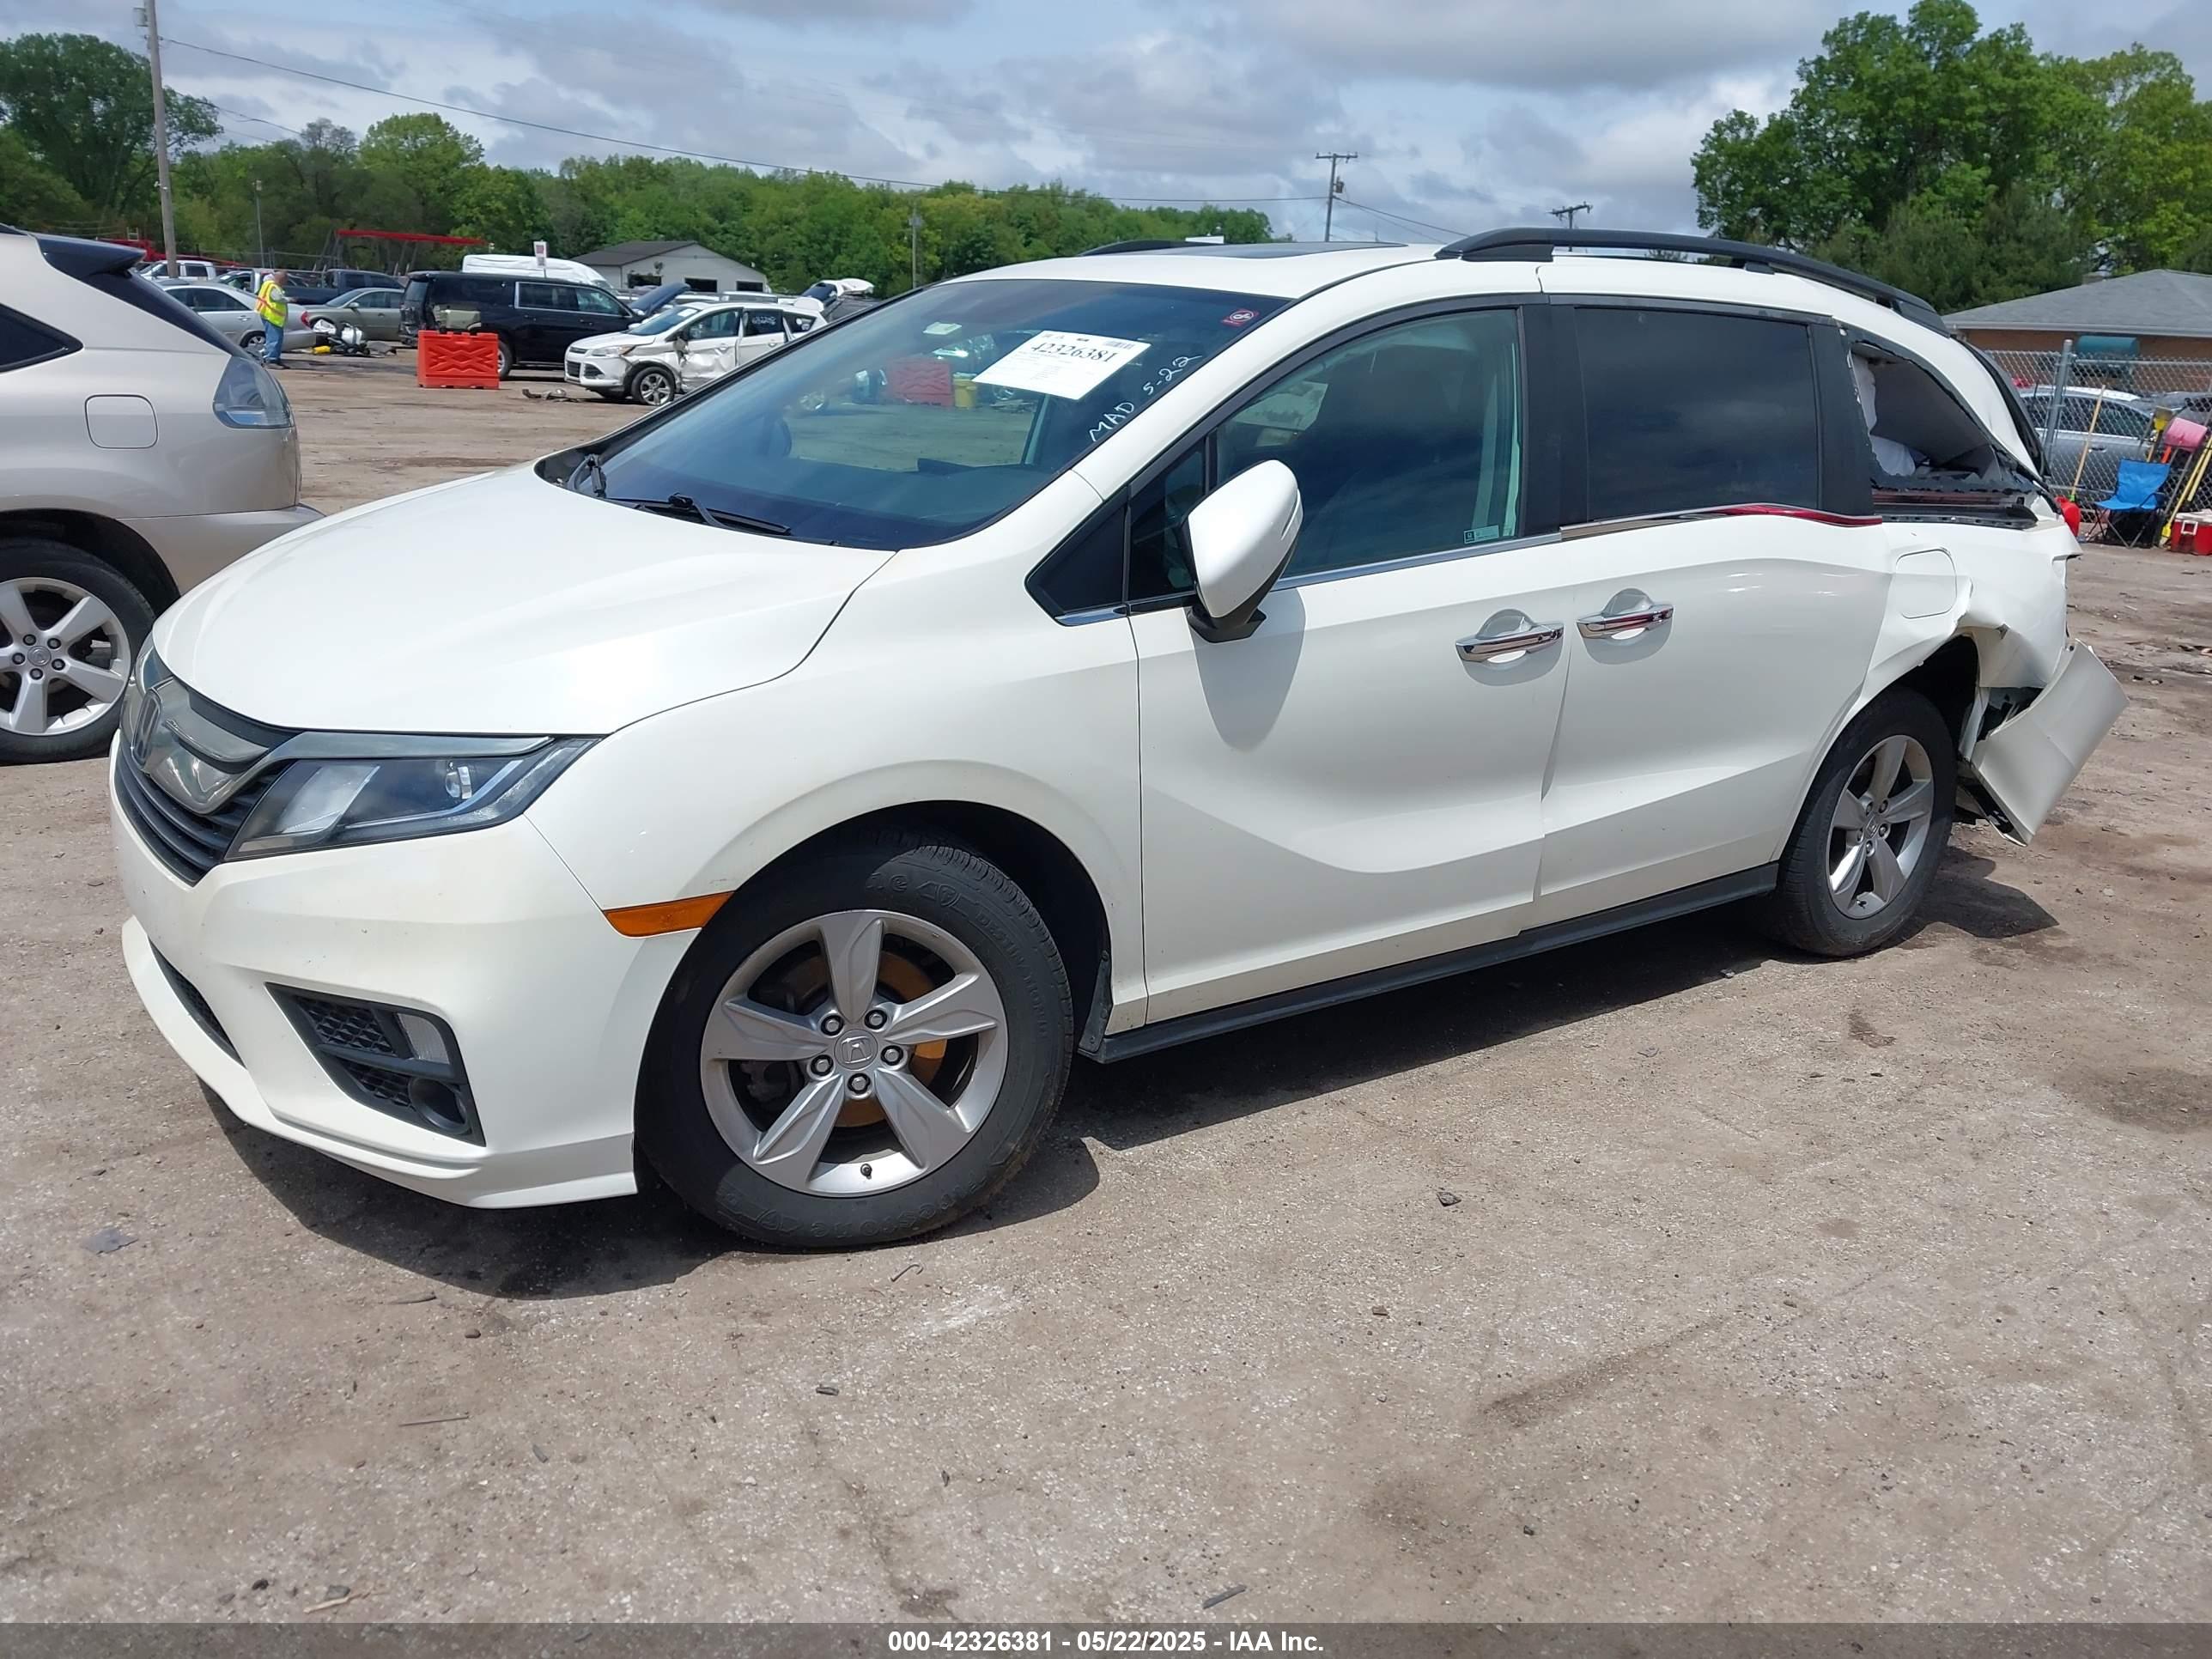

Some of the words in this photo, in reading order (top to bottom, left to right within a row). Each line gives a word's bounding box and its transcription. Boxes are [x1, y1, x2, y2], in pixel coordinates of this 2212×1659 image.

[1031, 342, 1119, 362] 42326381
[1089, 401, 1135, 442] MAD
[1142, 355, 1203, 396] 5-22
